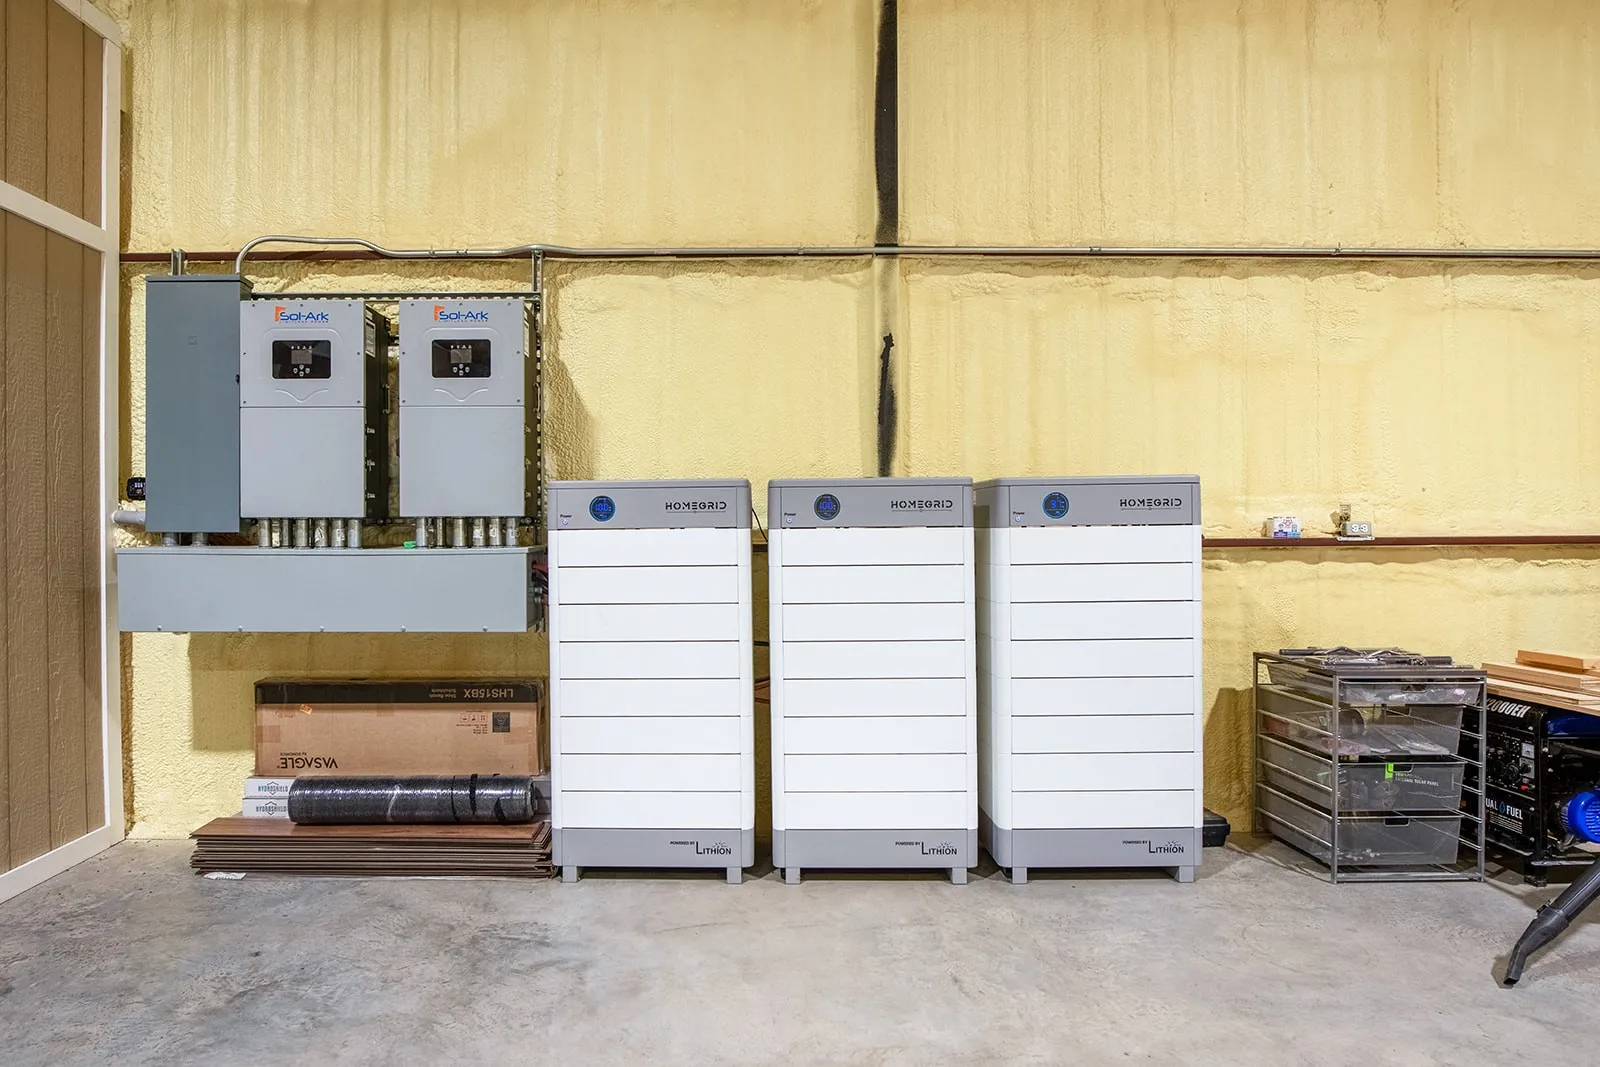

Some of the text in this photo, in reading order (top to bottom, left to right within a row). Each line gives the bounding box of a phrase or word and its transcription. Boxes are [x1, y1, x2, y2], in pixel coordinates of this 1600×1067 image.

[279, 311, 329, 321] Sol-Ark
[439, 310, 489, 320] Sol-Ark
[665, 501, 727, 510] HOMEGRID
[891, 500, 953, 509] HOMEGRID
[1119, 498, 1182, 507] HOMEGRID
[463, 688, 514, 698] LHS15BX
[1486, 698, 1531, 718] 2000EH
[279, 757, 338, 769] VASAGLE
[1485, 797, 1523, 820] UAL FUEL
